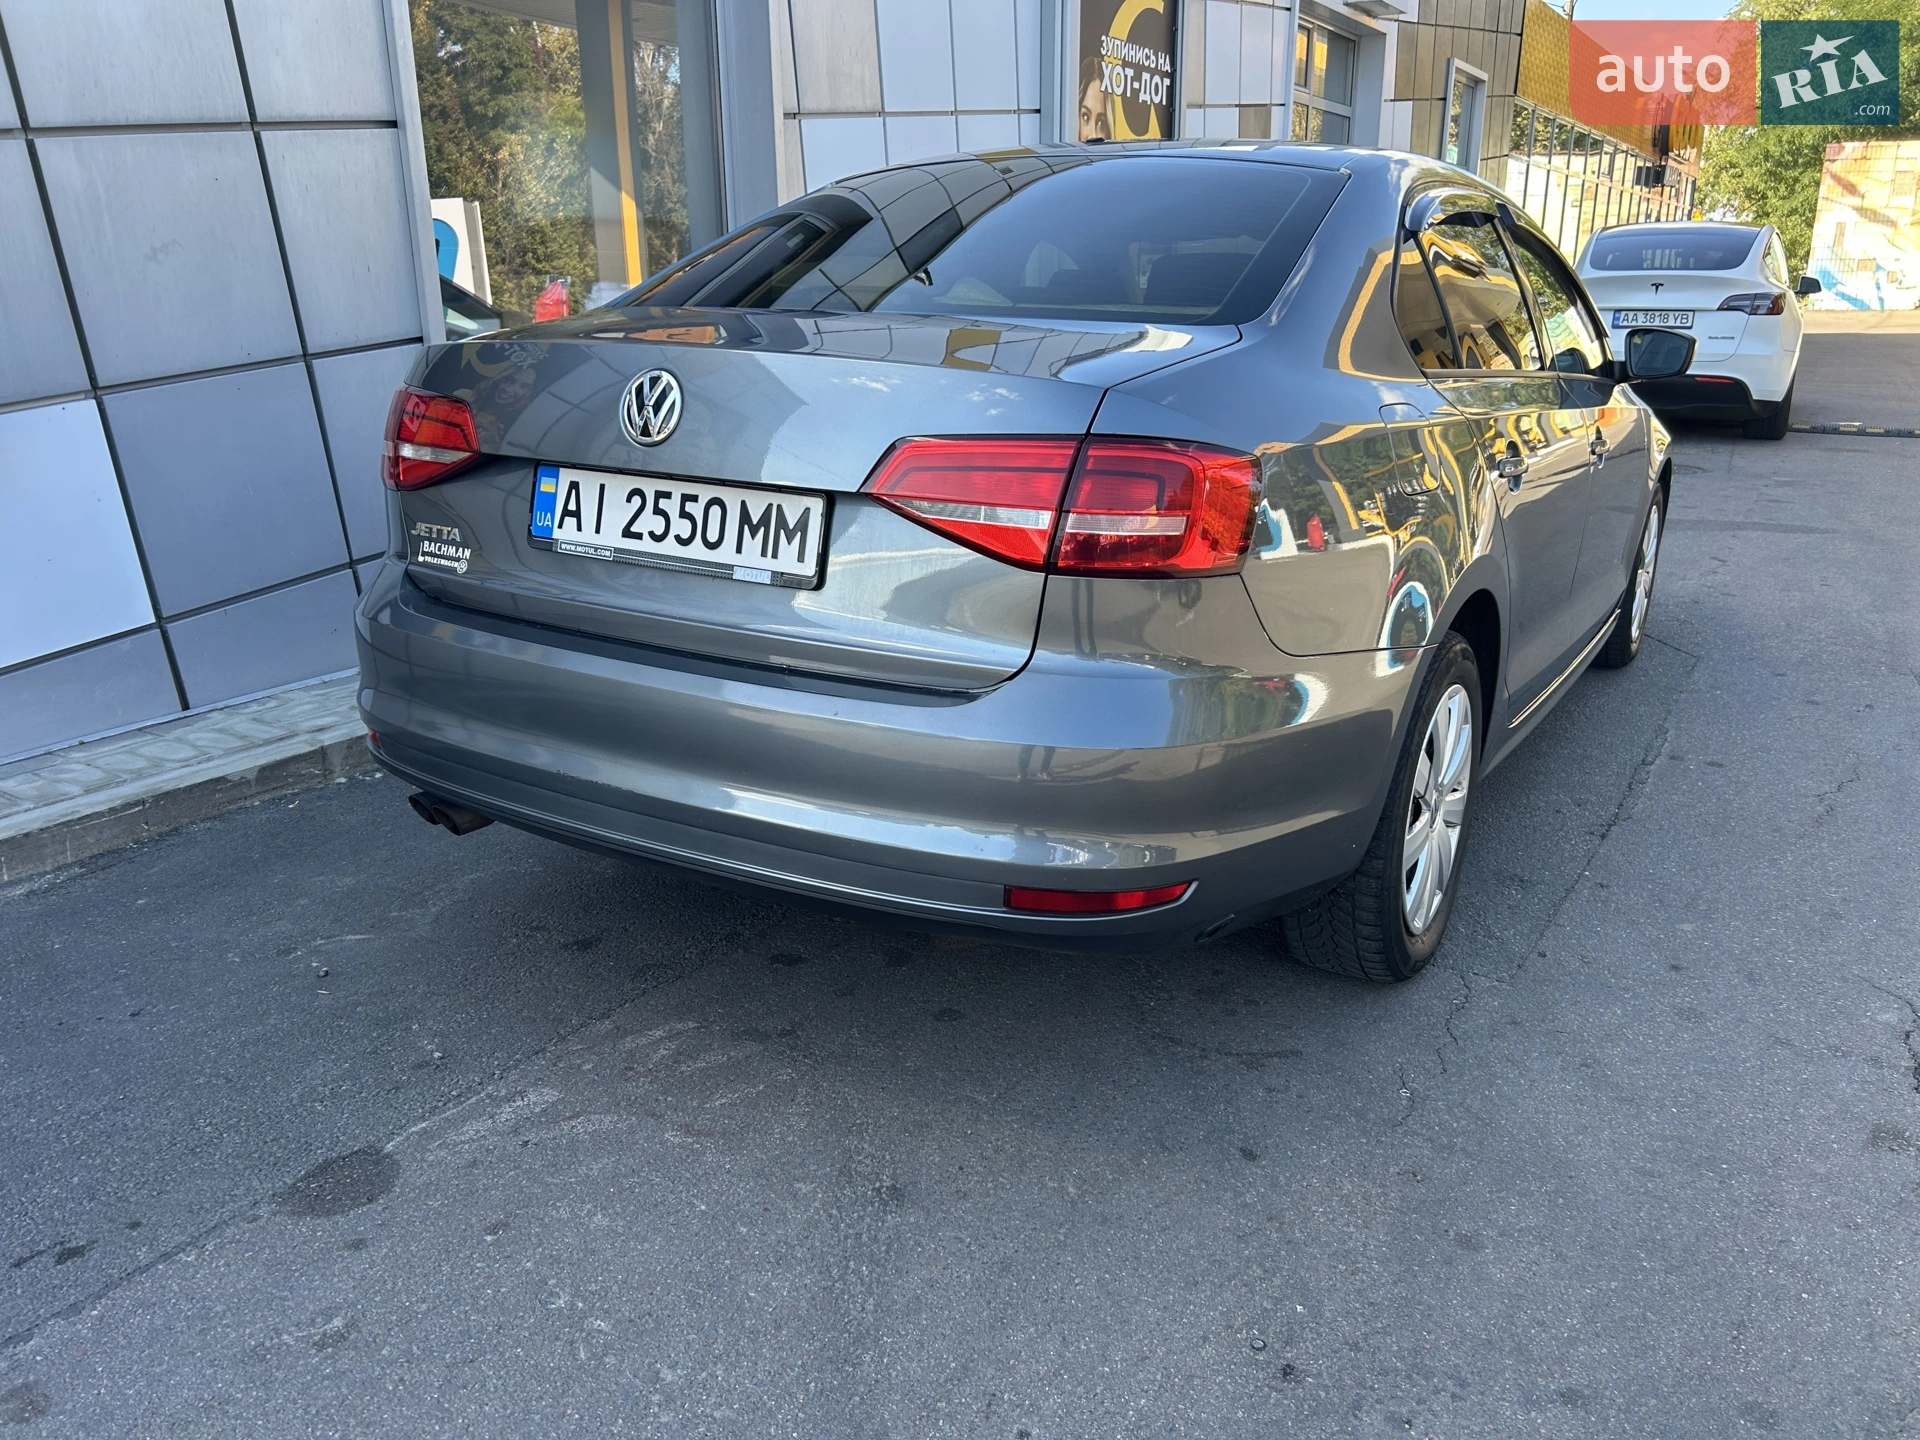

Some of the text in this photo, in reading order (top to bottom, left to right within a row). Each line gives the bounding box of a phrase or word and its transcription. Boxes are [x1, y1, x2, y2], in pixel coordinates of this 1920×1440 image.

[1100, 35, 1171, 73] ЗУПИНИСЬ НА
[1100, 61, 1171, 105] ХОТ-ДОГ
[1621, 313, 1638, 324] AA
[1641, 313, 1669, 324] 3818
[1672, 313, 1689, 325] YB
[536, 511, 552, 528] UA
[557, 480, 811, 563] AI 2550 MM
[410, 522, 461, 542] JETTA
[423, 540, 471, 560] BACHMAN
[560, 543, 611, 558] WWW.MOTUL.COM
[424, 555, 460, 568] VOLKSWAGEN
[734, 568, 770, 583] MOTUL
